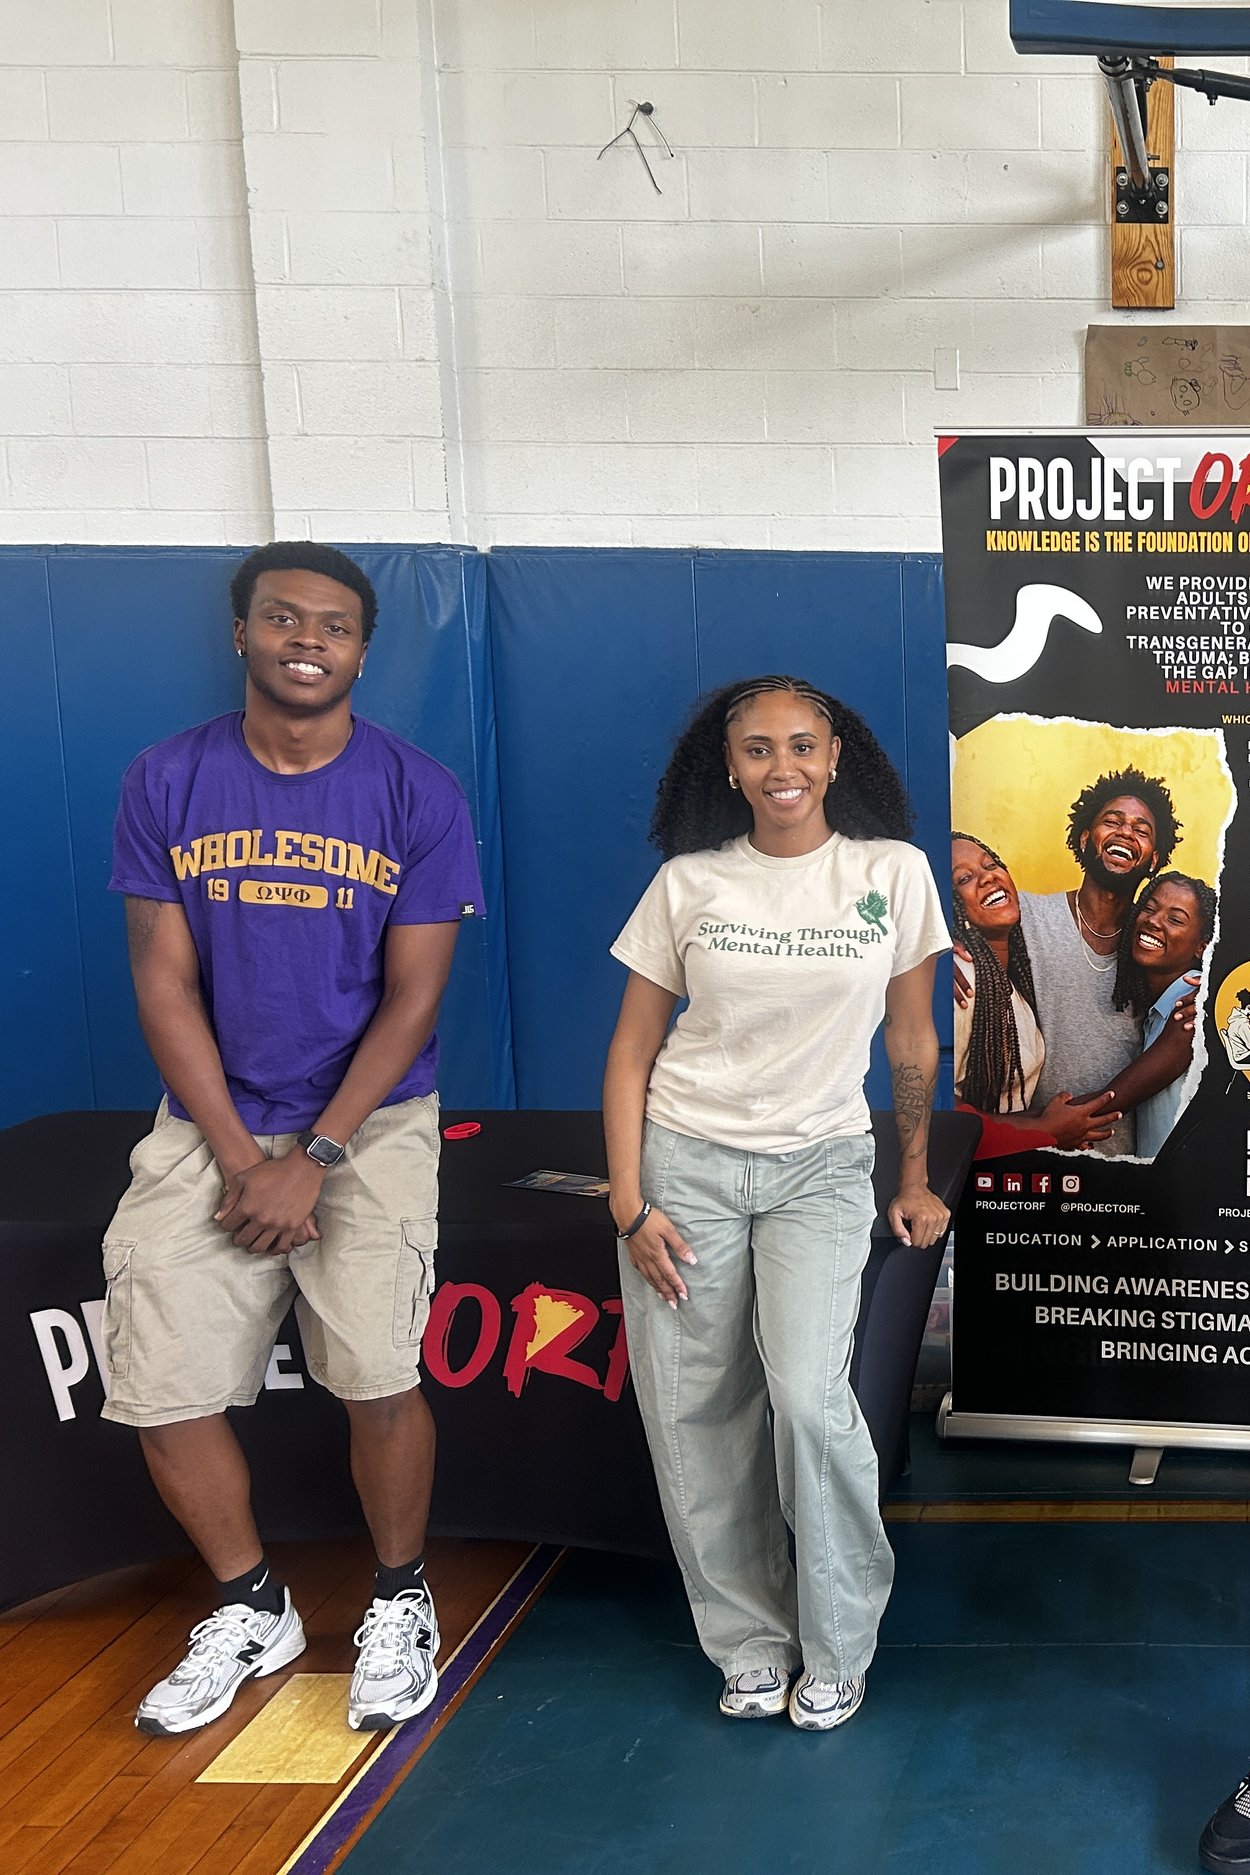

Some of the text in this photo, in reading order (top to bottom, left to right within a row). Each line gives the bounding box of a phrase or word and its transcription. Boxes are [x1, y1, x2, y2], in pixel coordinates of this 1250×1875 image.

[990, 457, 1181, 520] PROJECT
[986, 530, 1080, 553] KNOWLEDGE
[1085, 531, 1100, 553] IS
[1105, 531, 1132, 553] THE
[1137, 531, 1233, 553] FOUNDATION
[1146, 577, 1174, 590] WE
[1176, 591, 1247, 605] ADULTS
[1220, 622, 1245, 635] TO
[1153, 651, 1233, 665] TRAUMA;
[1161, 665, 1196, 679] THE
[1201, 665, 1237, 679] GAP
[1165, 681, 1239, 694] MENTAL
[170, 829, 401, 896] WHOLESOME
[206, 878, 229, 901] 19
[335, 887, 354, 909] 11
[698, 921, 882, 945] Surviving Through
[707, 937, 864, 960] Mental Health.
[976, 1201, 1046, 1211] PROJECTORF
[1060, 1202, 1145, 1215] @PROJECTORF_
[986, 1232, 1082, 1246] EDUCATION
[1107, 1236, 1217, 1252] APPLICATION
[995, 1273, 1109, 1294] BUILDING
[1035, 1306, 1155, 1328] BREAKING
[1101, 1340, 1217, 1363] BRINGING
